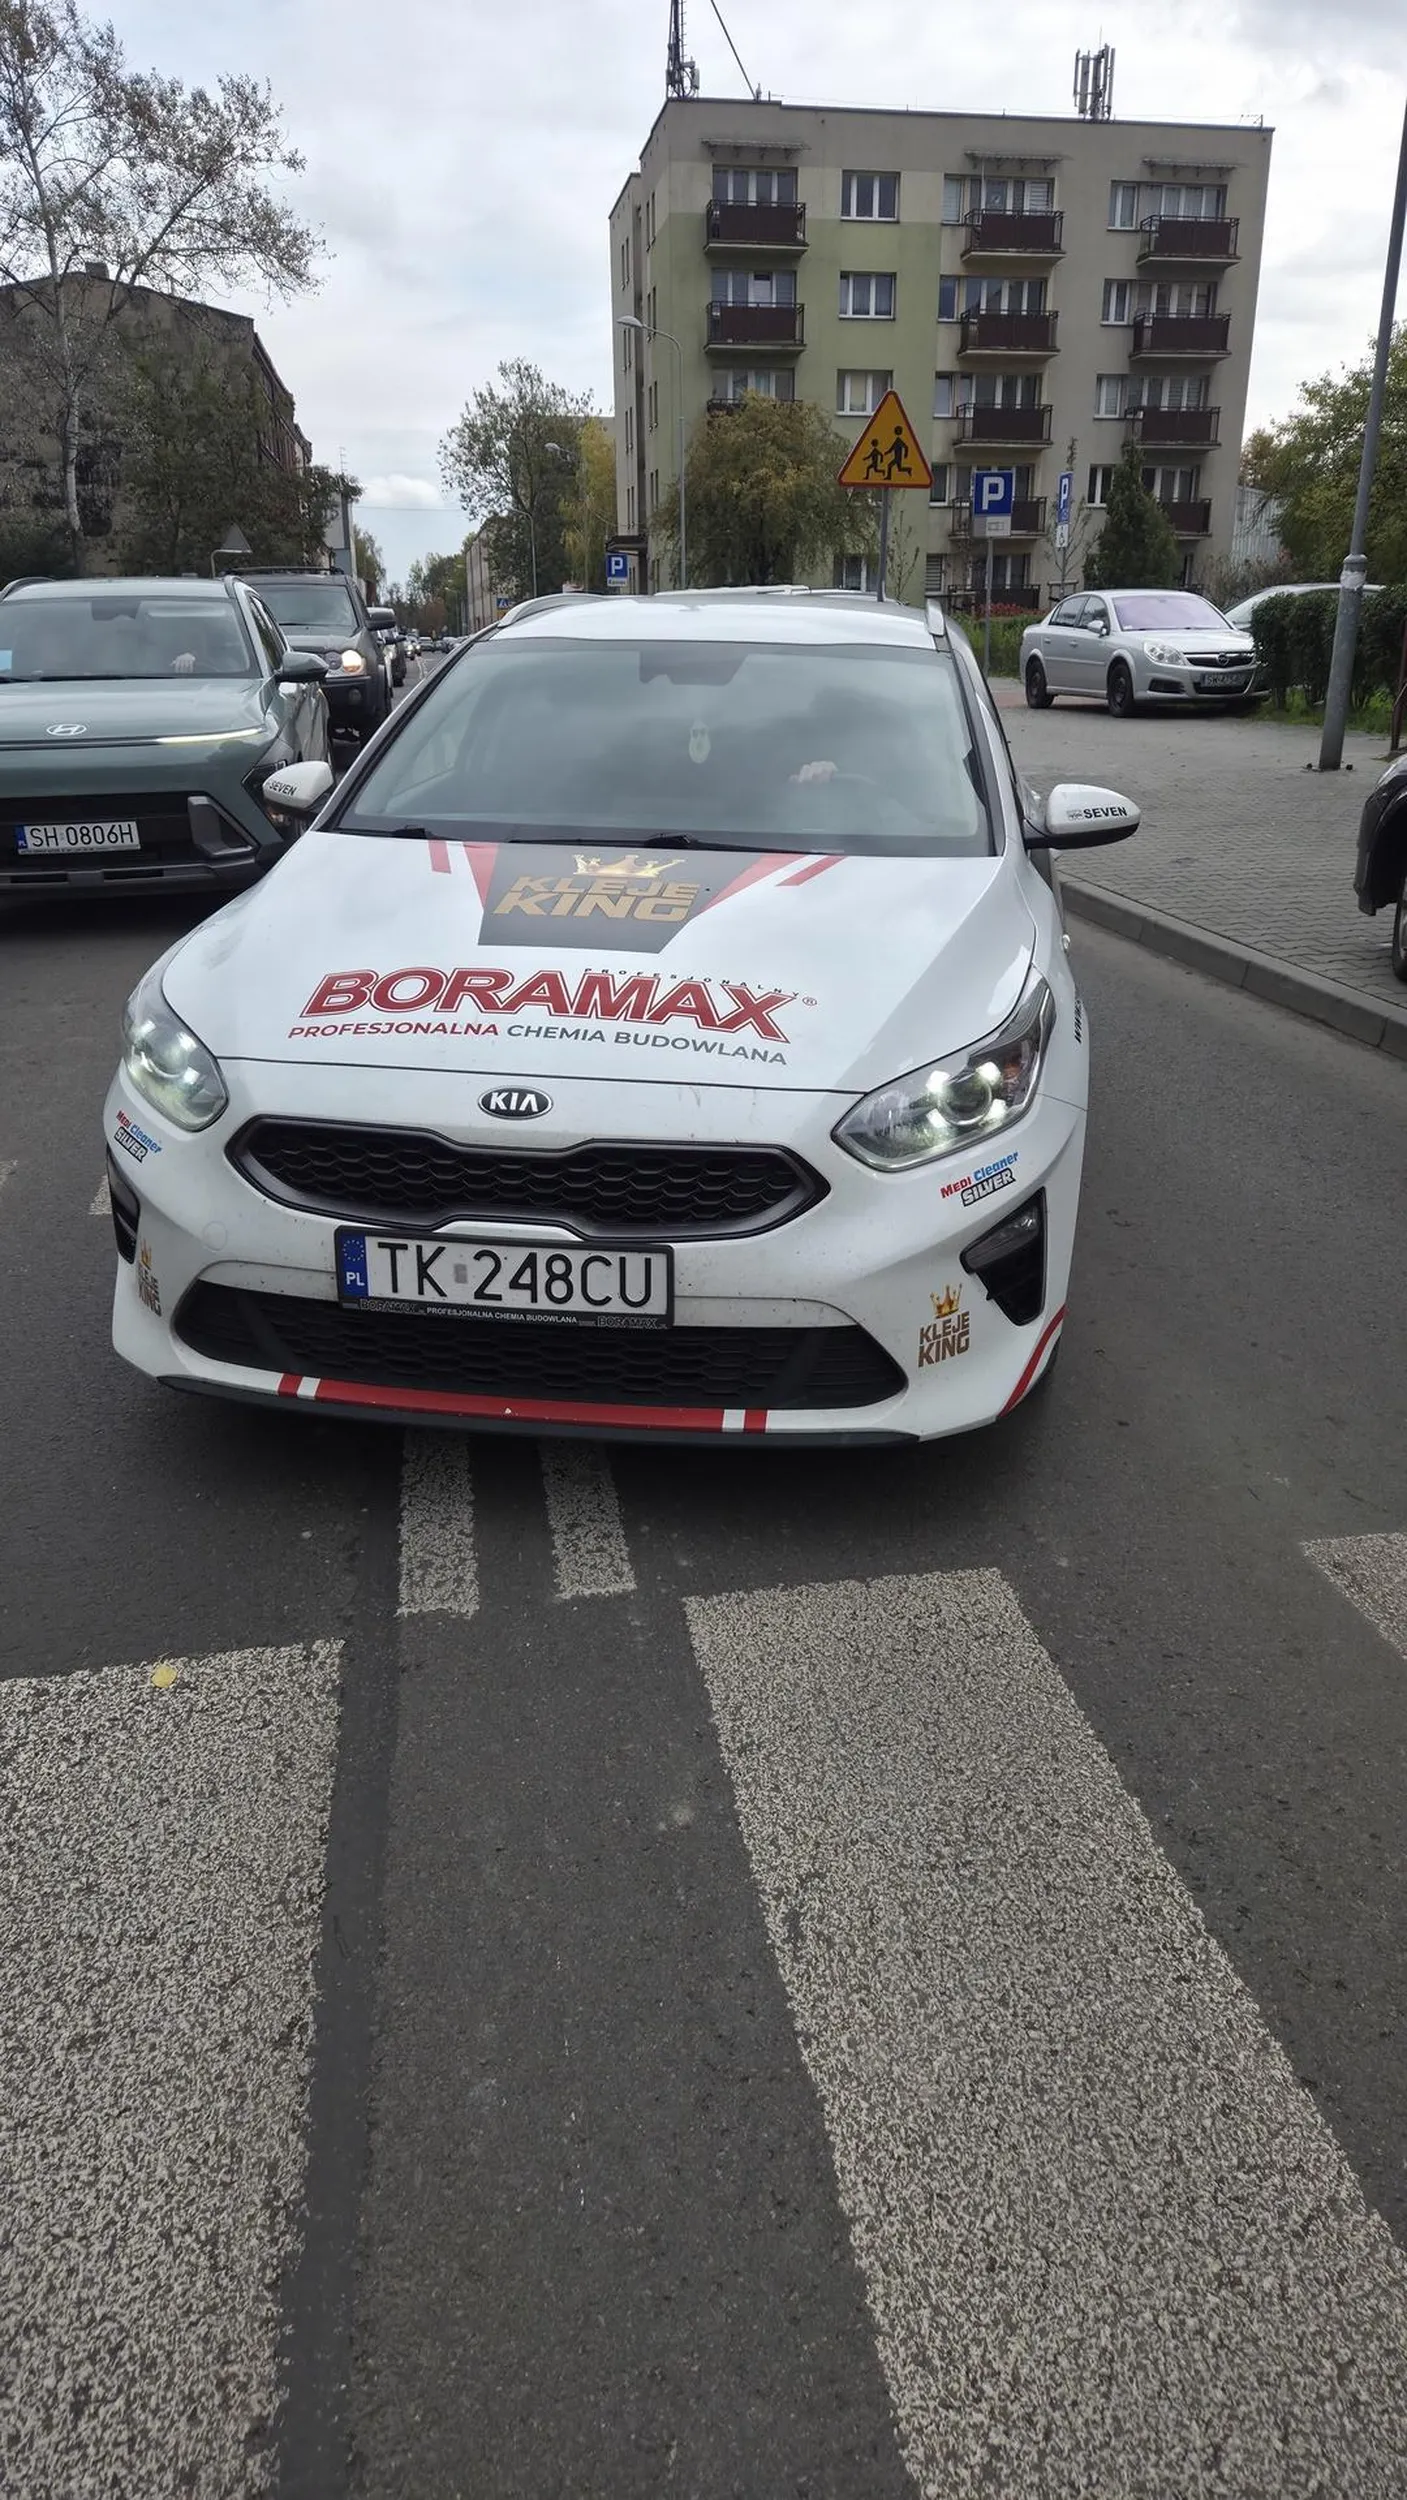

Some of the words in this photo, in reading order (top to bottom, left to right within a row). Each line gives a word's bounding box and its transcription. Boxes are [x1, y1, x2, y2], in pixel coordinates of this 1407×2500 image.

[982, 476, 1005, 510] P
[611, 556, 624, 575] P
[268, 781, 297, 796] SEVEN
[1083, 807, 1127, 819] SEVEN
[30, 827, 59, 847] SH
[65, 823, 134, 846] 0806H
[511, 876, 700, 900] KLEJE
[493, 891, 693, 922] KING
[299, 967, 791, 1044] BORAMAX
[288, 1022, 499, 1039] PROFESJONALNA
[507, 1024, 606, 1043] CHEMIA
[614, 1031, 788, 1065] BUDOWLANA
[489, 1091, 539, 1112] KIA
[114, 1127, 148, 1162] SILVER
[973, 1151, 1019, 1182] Cleaner
[962, 1169, 1015, 1206] SILVER
[346, 1271, 365, 1287] PL
[377, 1241, 448, 1298] TK
[473, 1249, 652, 1308] 248CU
[426, 1307, 493, 1319] PROFESJONALNA
[494, 1311, 525, 1321] CHEMIA
[526, 1313, 577, 1324] BUDOWLANA
[920, 1311, 970, 1345] KLEJE
[918, 1330, 970, 1368] KING
